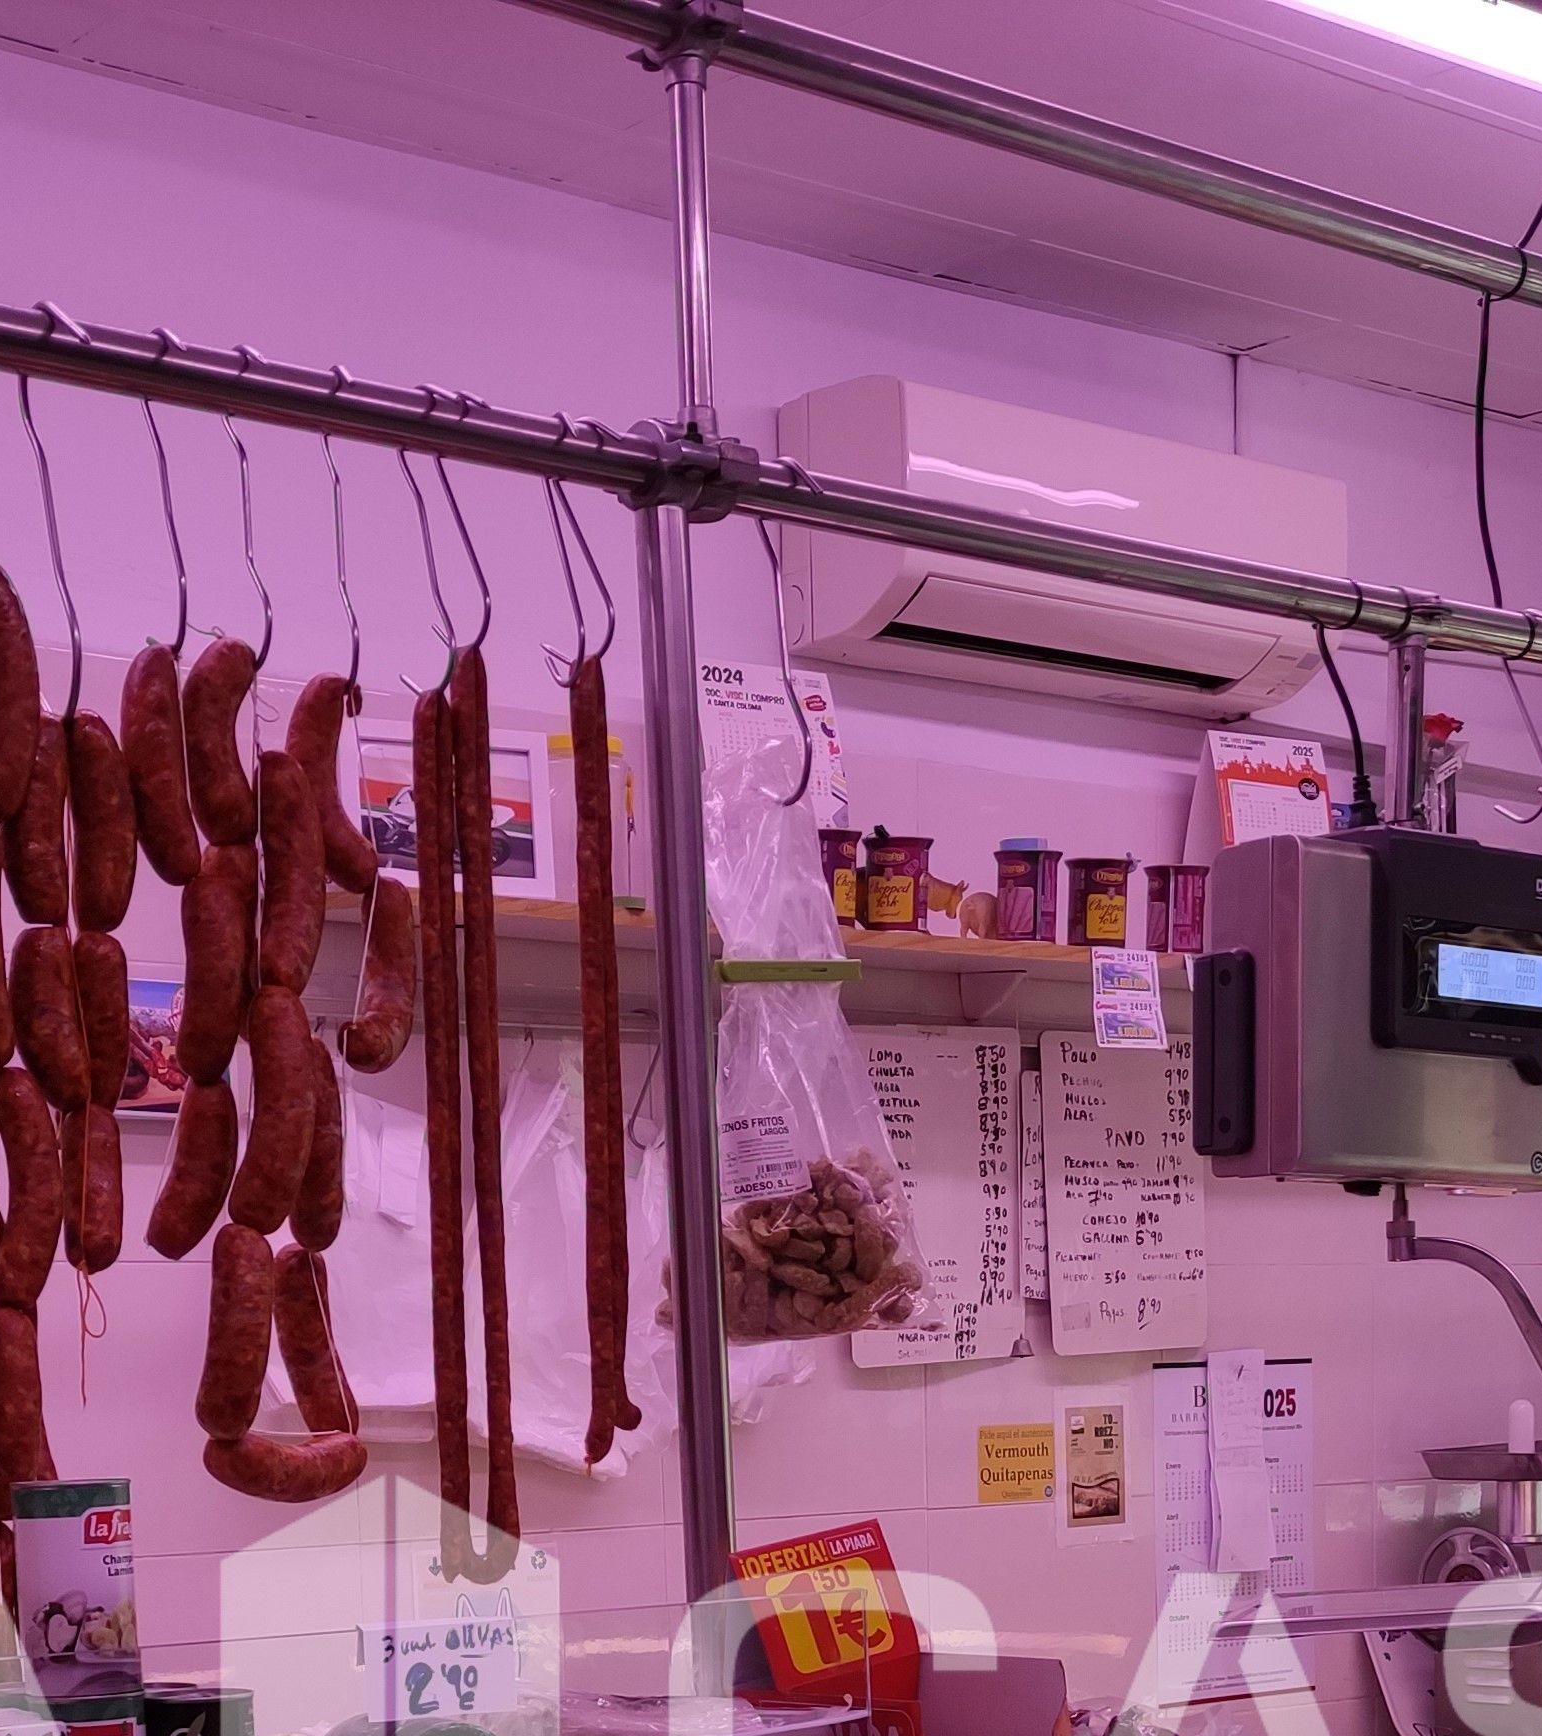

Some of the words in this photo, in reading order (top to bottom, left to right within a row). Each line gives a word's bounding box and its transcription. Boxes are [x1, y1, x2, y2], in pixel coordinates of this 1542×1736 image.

[701, 665, 744, 686] 2024
[1292, 745, 1313, 757] 2025
[869, 1048, 902, 1063] LOMO
[879, 1097, 921, 1108] OSTILLA
[751, 1116, 785, 1128] FRITOS
[759, 1126, 790, 1136] LARGOS
[1105, 1127, 1145, 1147] PAVO
[1263, 1388, 1296, 1418] 025
[984, 1441, 1049, 1459] Vermouth
[980, 1467, 1054, 1486] Quitapenas
[738, 1539, 829, 1581] ¡OFERTA!
[829, 1541, 843, 1555] LA
[843, 1532, 876, 1551] PIARA
[382, 1635, 396, 1663] 3
